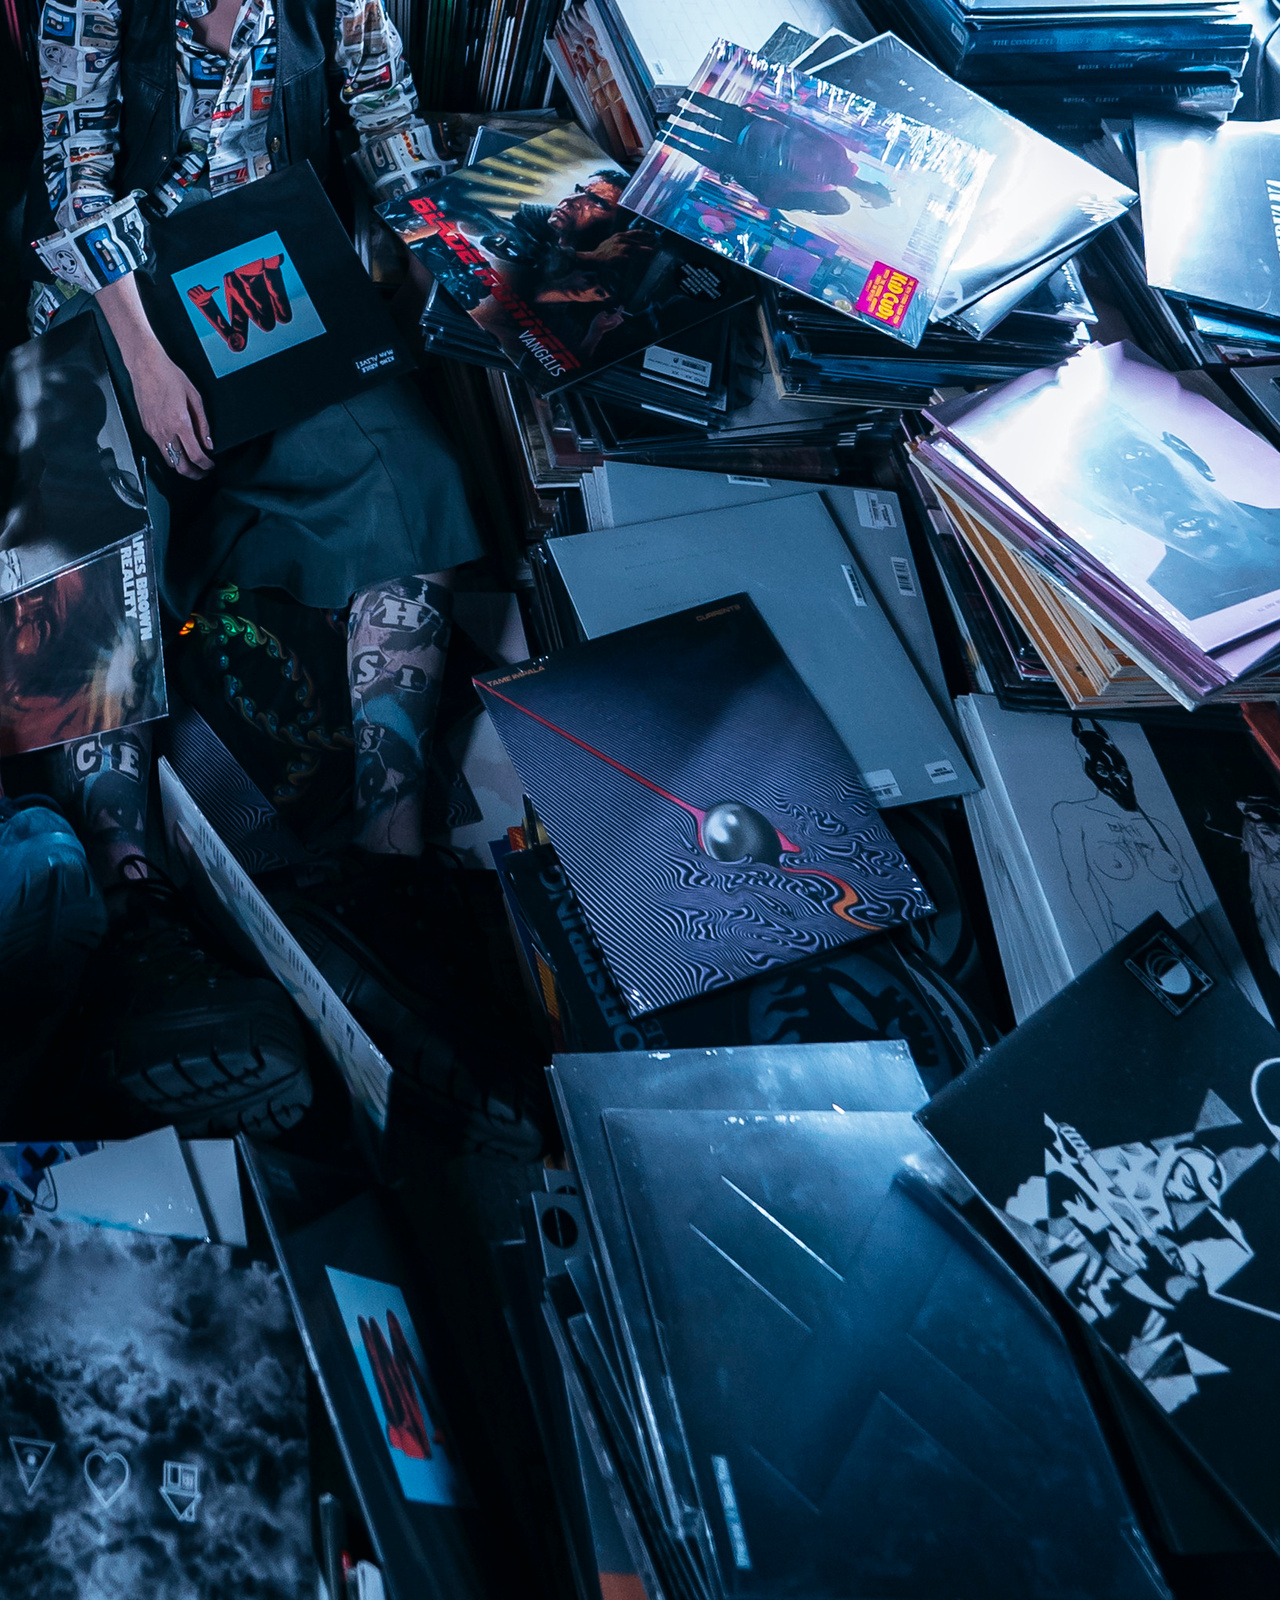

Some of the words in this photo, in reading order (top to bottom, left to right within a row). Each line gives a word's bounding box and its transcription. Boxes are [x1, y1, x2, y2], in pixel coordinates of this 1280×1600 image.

[519, 330, 566, 377] VANGELIS
[120, 546, 138, 619] REALITY
[136, 577, 152, 640] BROWN
[696, 604, 741, 622] CURRENTS
[487, 676, 511, 688] TAME
[511, 665, 546, 682] IMPALA
